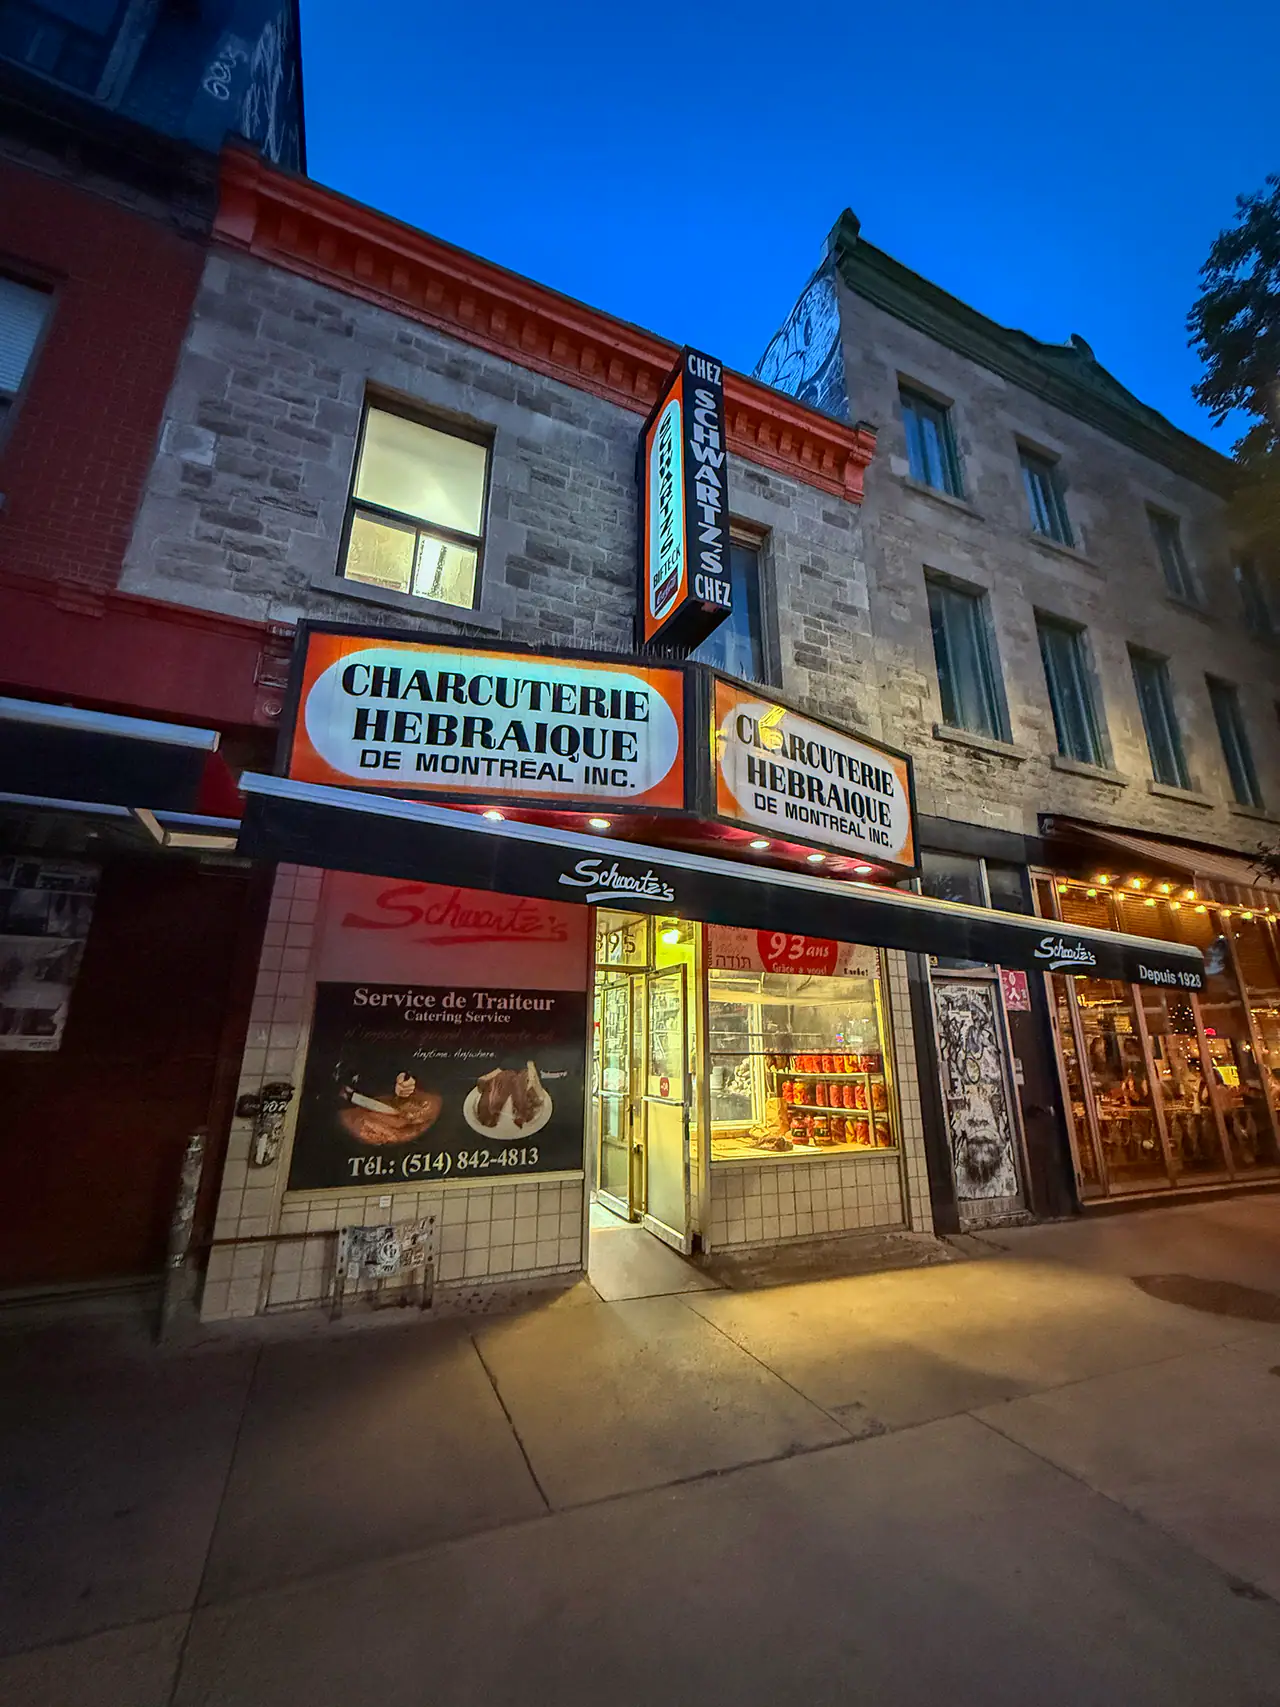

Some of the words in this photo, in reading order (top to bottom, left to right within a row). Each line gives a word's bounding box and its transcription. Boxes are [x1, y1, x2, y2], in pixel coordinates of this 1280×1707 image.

[687, 354, 722, 386] CHEZ
[690, 388, 726, 574] SCHWARTZ'S
[694, 573, 732, 607] CHEZ
[341, 663, 650, 723] CHARCUTERIE
[352, 707, 639, 763] HEBRAIQUE
[359, 748, 402, 769] DE
[584, 765, 636, 788] INC.
[747, 754, 892, 825] HEBRAIQUE
[754, 792, 778, 814] DE
[869, 827, 893, 848] INC.
[558, 859, 675, 902] Schwartz's
[341, 884, 568, 945] Schwartz's
[768, 932, 805, 961] 93
[806, 943, 830, 958] ans
[1034, 937, 1097, 970] Schwartz's
[1138, 964, 1178, 985] Depuis
[1177, 972, 1203, 988] 1928
[353, 988, 437, 1009] Service
[441, 992, 467, 1009] de
[472, 992, 556, 1012] Traiteur
[404, 1009, 462, 1025] Catering
[465, 1010, 511, 1023] Service
[348, 1156, 397, 1177] Tél.:
[401, 1152, 452, 1177] (514)
[456, 1147, 540, 1170] 842-4813
